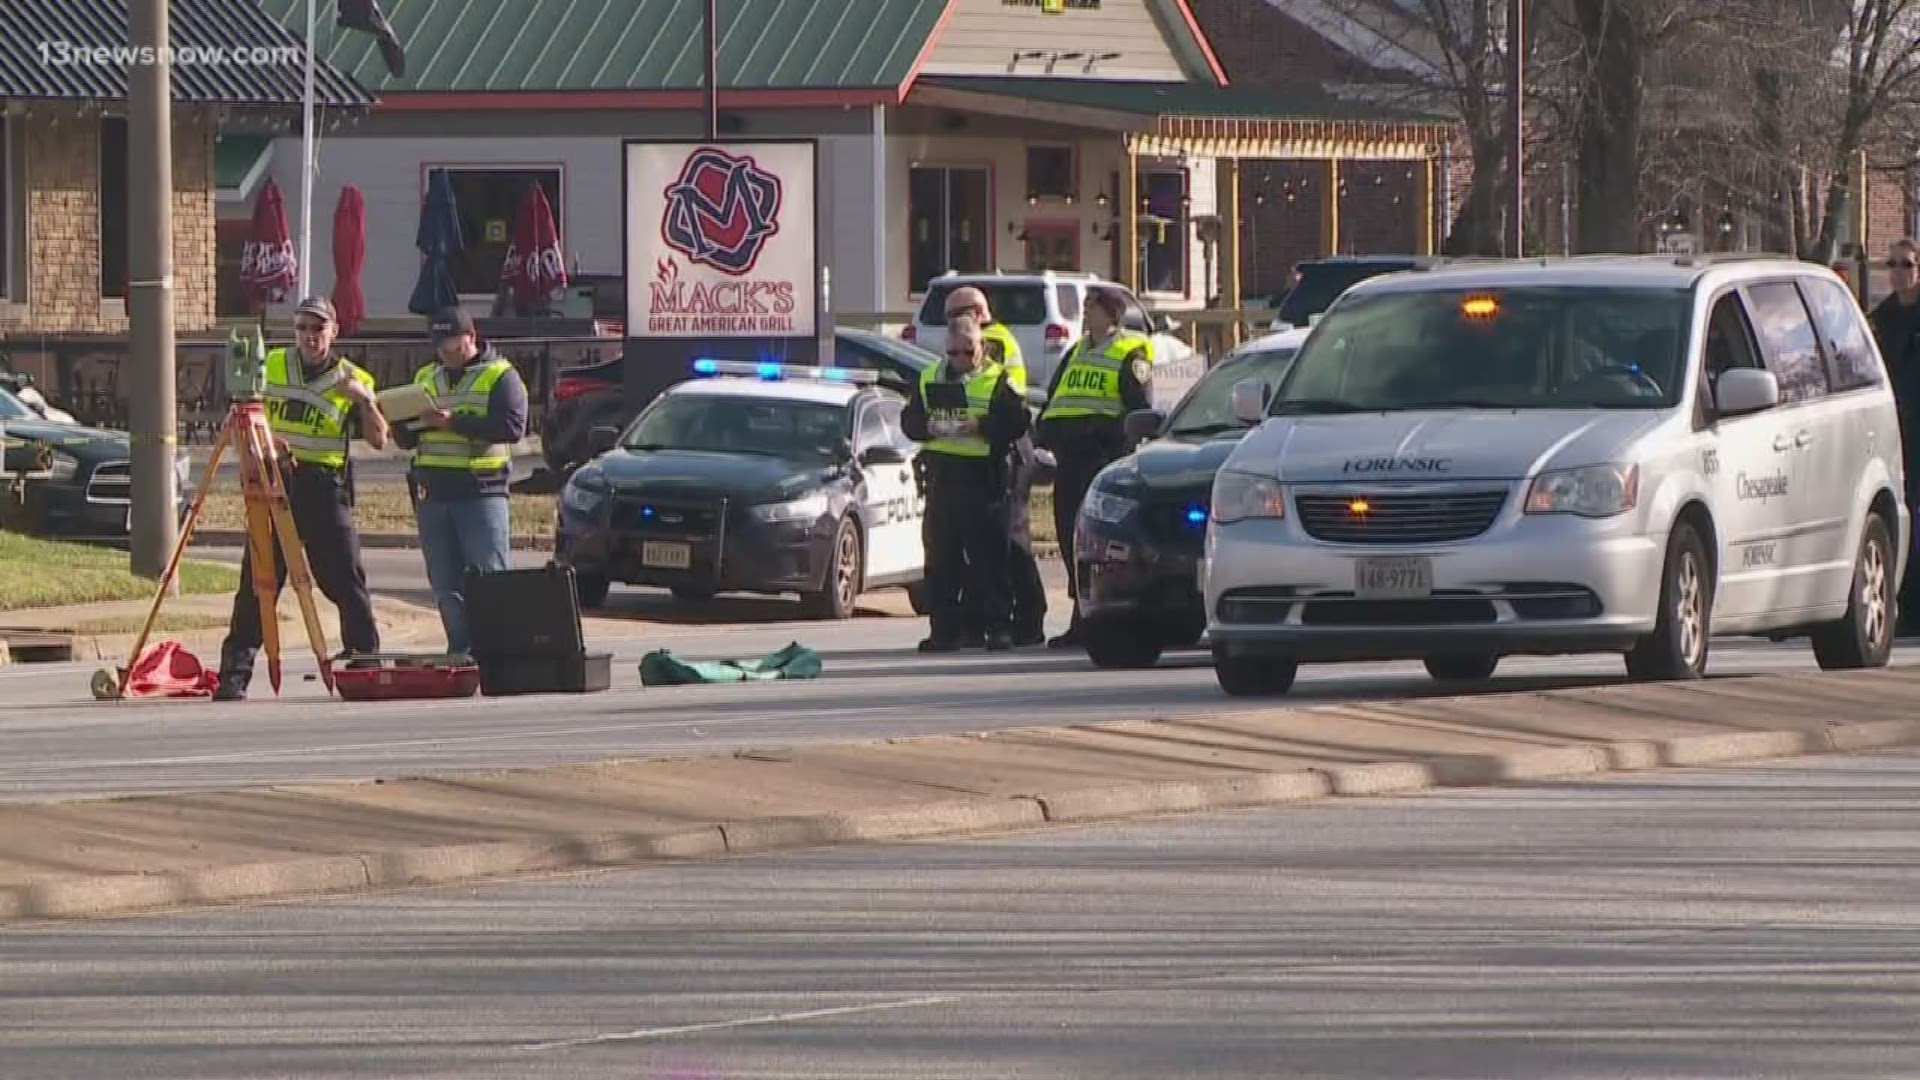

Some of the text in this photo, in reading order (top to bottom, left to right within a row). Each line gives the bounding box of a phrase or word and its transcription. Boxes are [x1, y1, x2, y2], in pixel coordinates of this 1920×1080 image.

[648, 281, 795, 314] MACK'S
[648, 317, 793, 332] GREAT AMERICAN GRILL
[1062, 369, 1108, 391] OLICE
[268, 400, 325, 433] POICE
[1343, 457, 1453, 474] FORENSIC
[1736, 468, 1789, 503] Chesapeake
